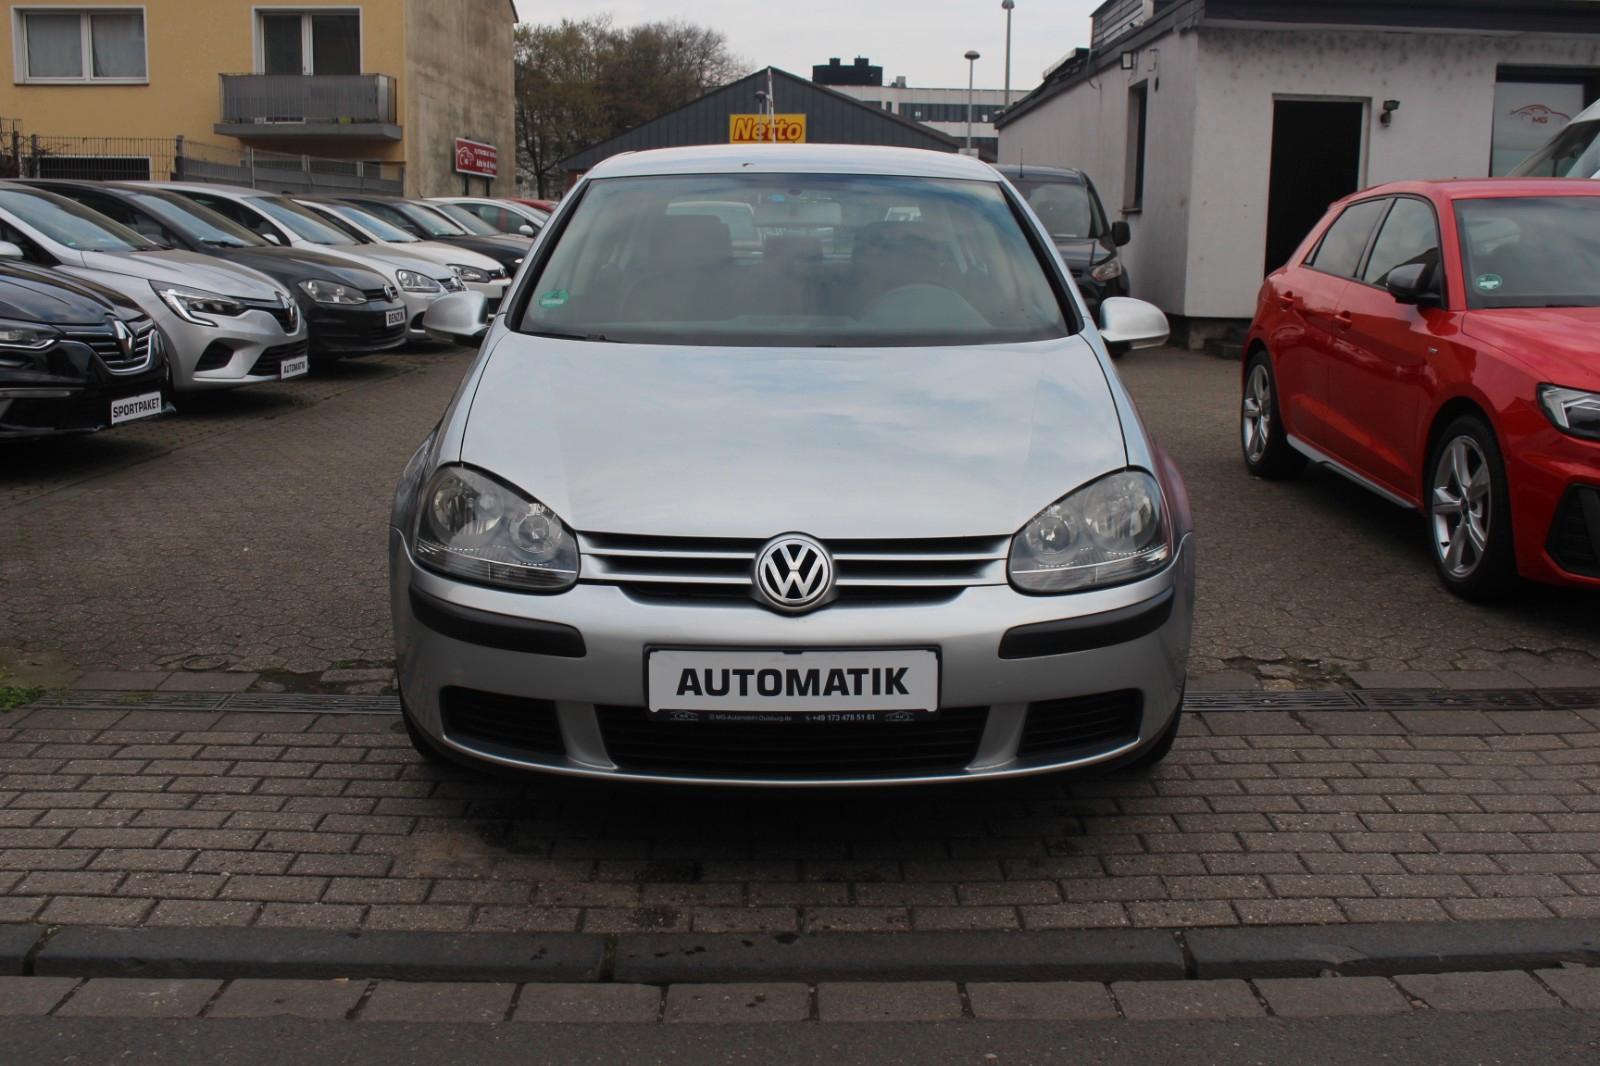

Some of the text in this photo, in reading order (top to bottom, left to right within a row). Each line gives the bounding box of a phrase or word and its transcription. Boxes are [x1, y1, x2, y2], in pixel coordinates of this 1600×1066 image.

[733, 117, 803, 142] Netto
[113, 397, 160, 418] SPORTPAKET
[676, 667, 910, 696] AUTOMATIK
